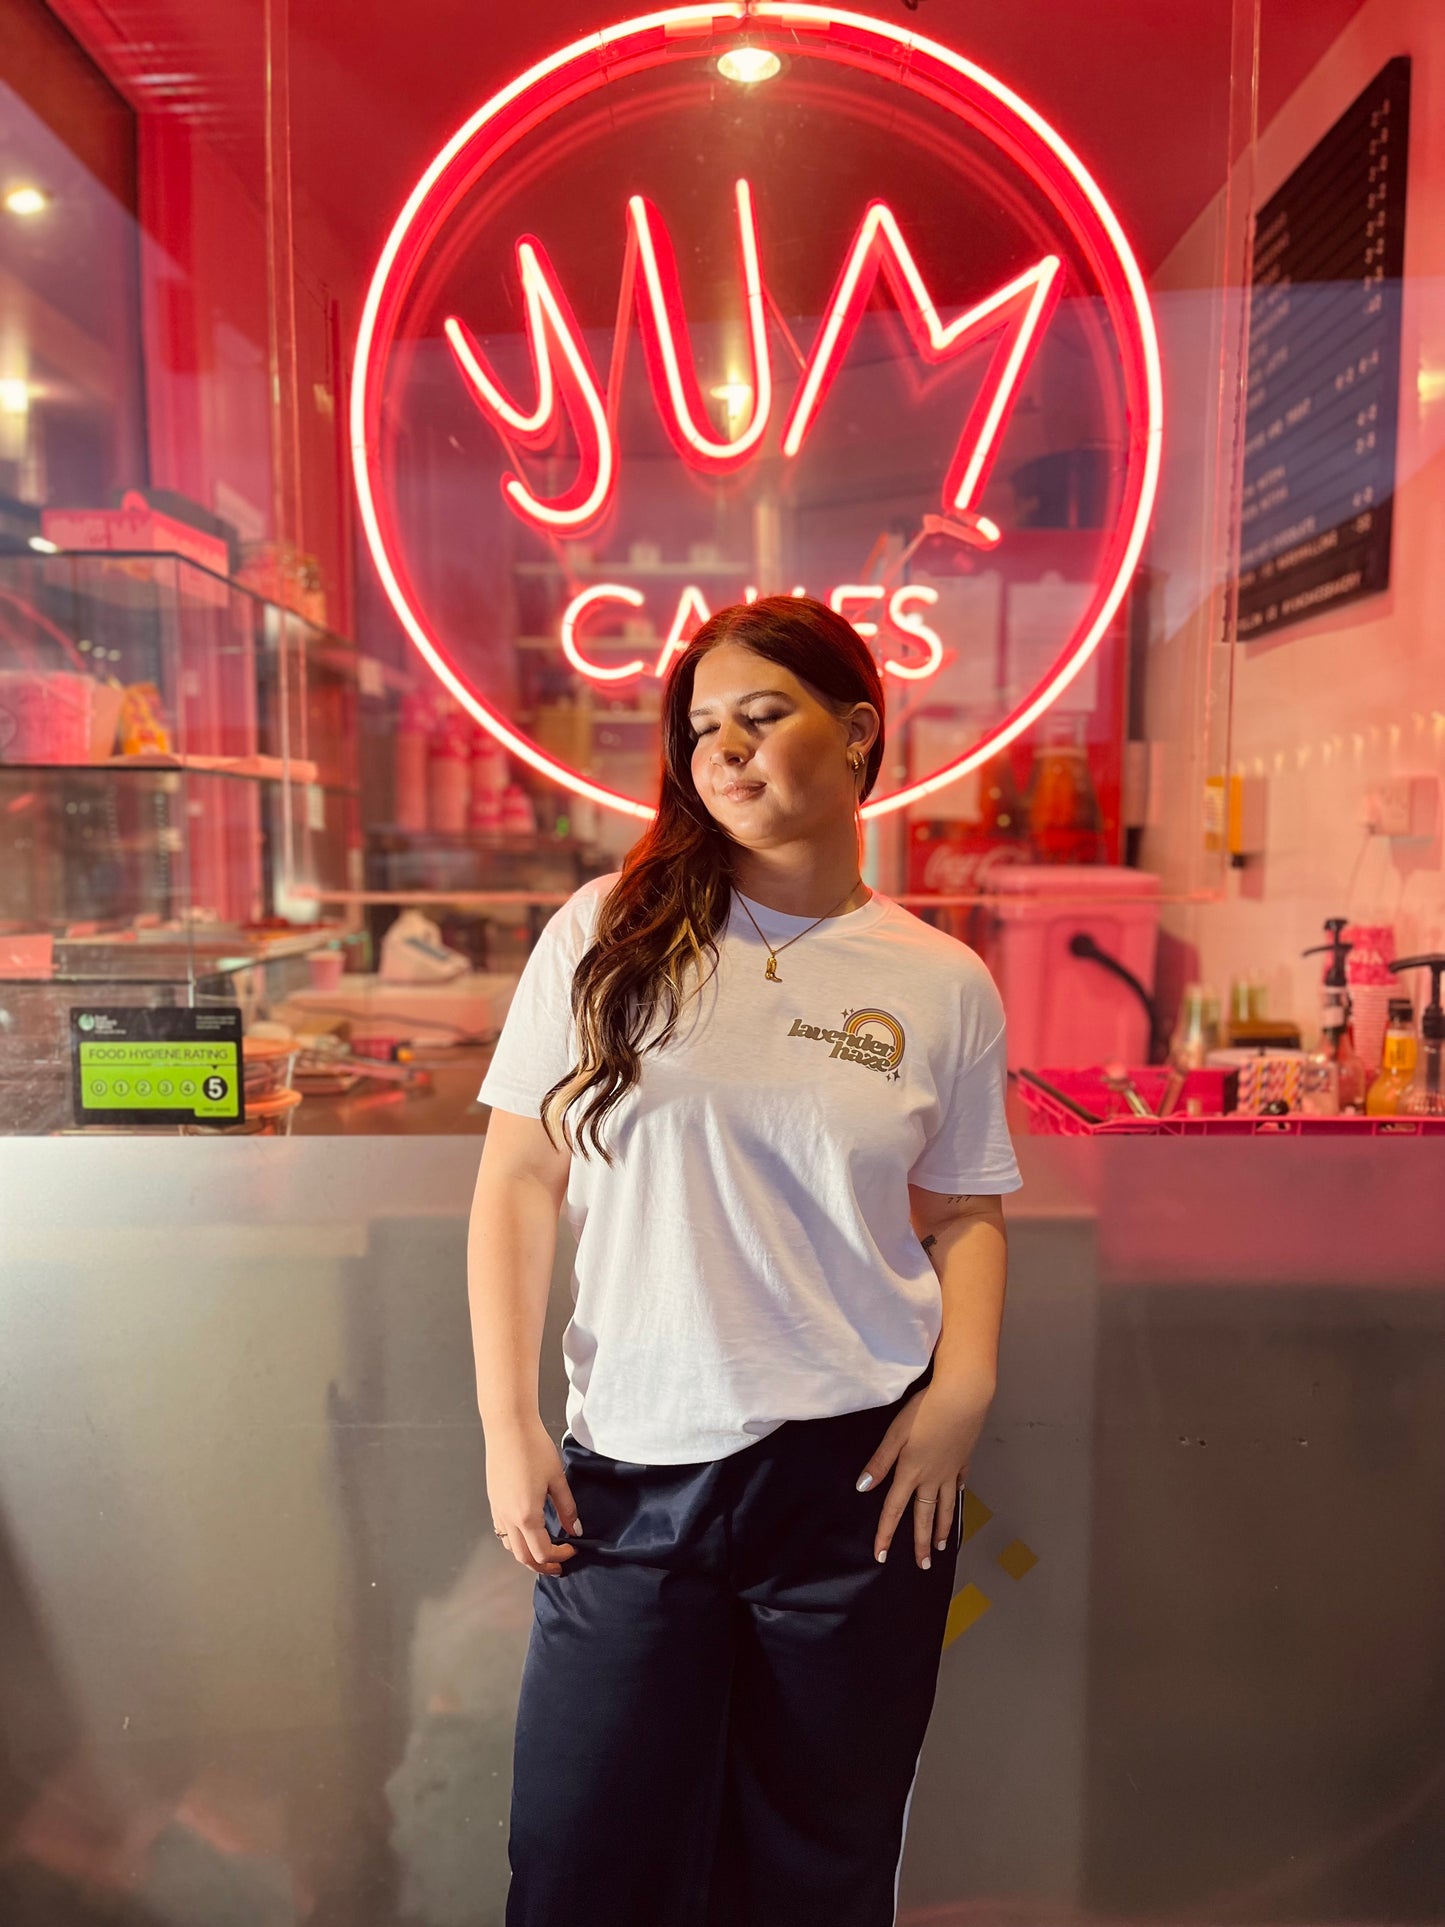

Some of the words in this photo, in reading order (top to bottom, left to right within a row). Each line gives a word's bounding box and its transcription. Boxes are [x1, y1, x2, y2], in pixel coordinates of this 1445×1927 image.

[441, 177, 1066, 536] YUM
[787, 1018, 896, 1057] lavender
[88, 1048, 126, 1060] FOOD
[129, 1048, 181, 1060] HYGIENE
[184, 1048, 228, 1060] RATING
[828, 1040, 891, 1072] haze
[208, 1078, 223, 1099] 5
